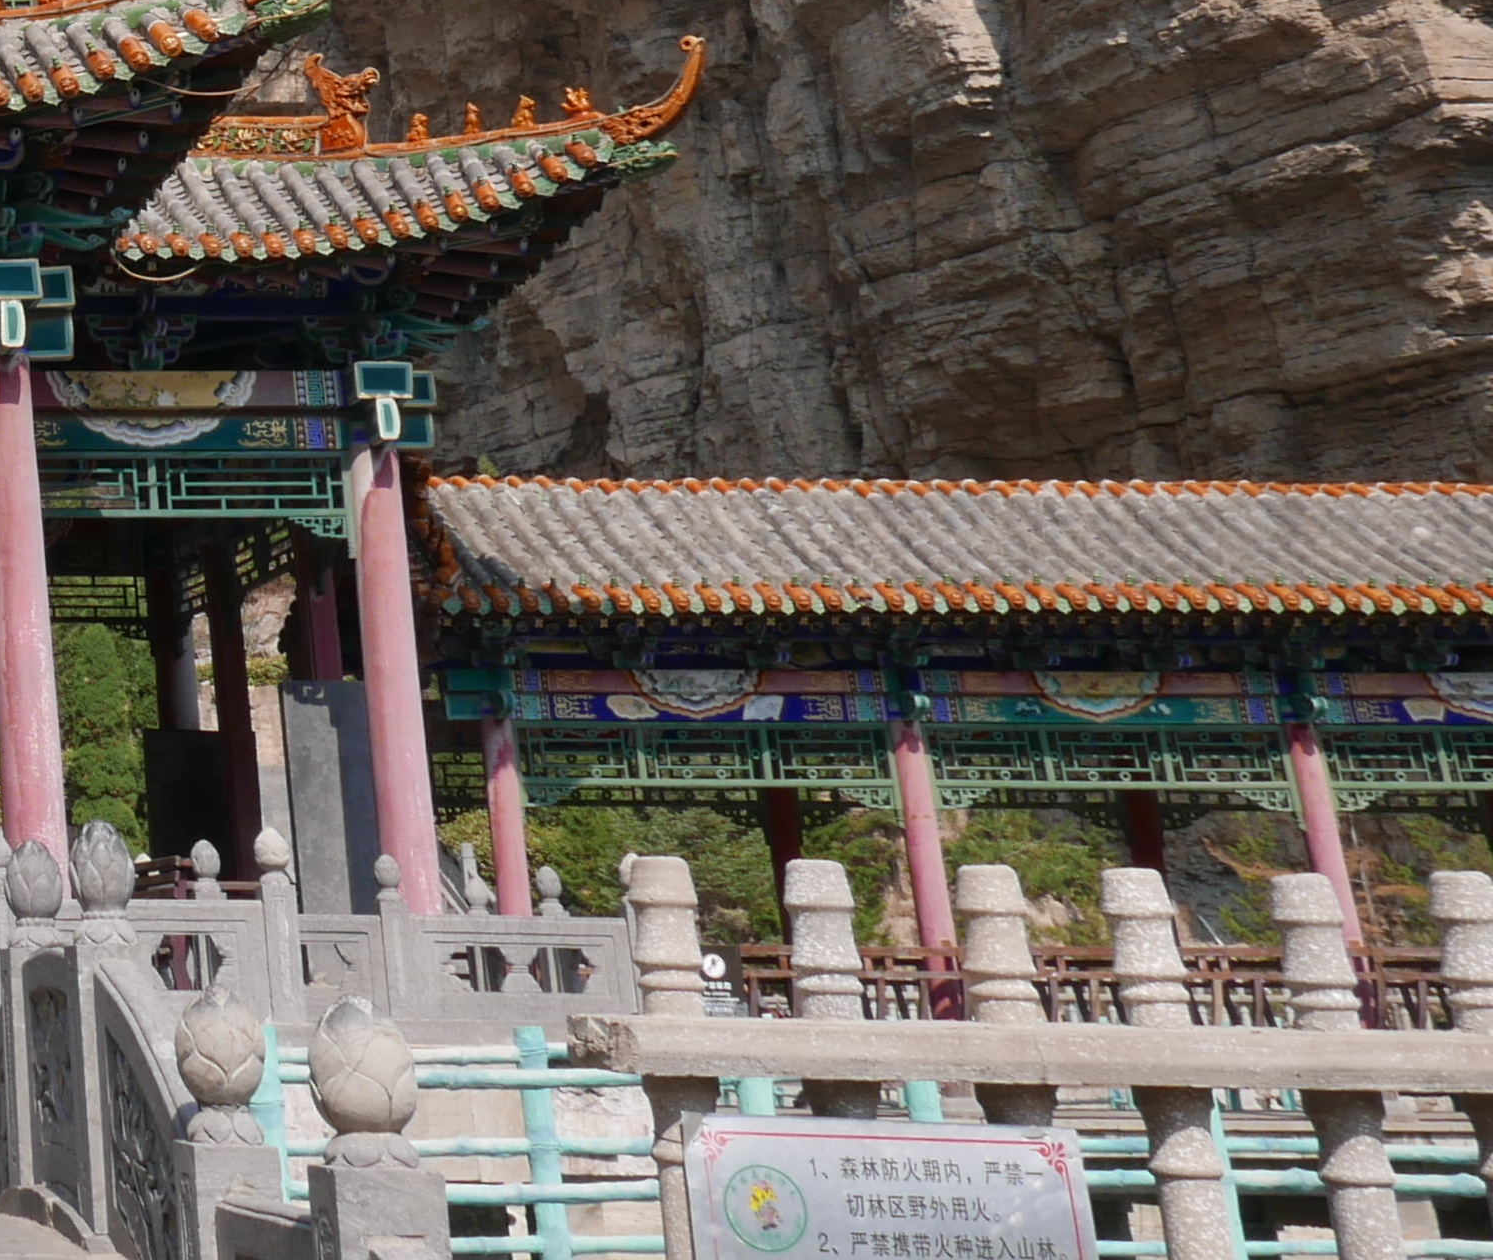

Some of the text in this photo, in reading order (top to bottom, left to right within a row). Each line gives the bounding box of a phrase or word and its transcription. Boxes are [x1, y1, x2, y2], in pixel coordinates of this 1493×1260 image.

[845, 1193, 1001, 1223] 切林区野外用火。
